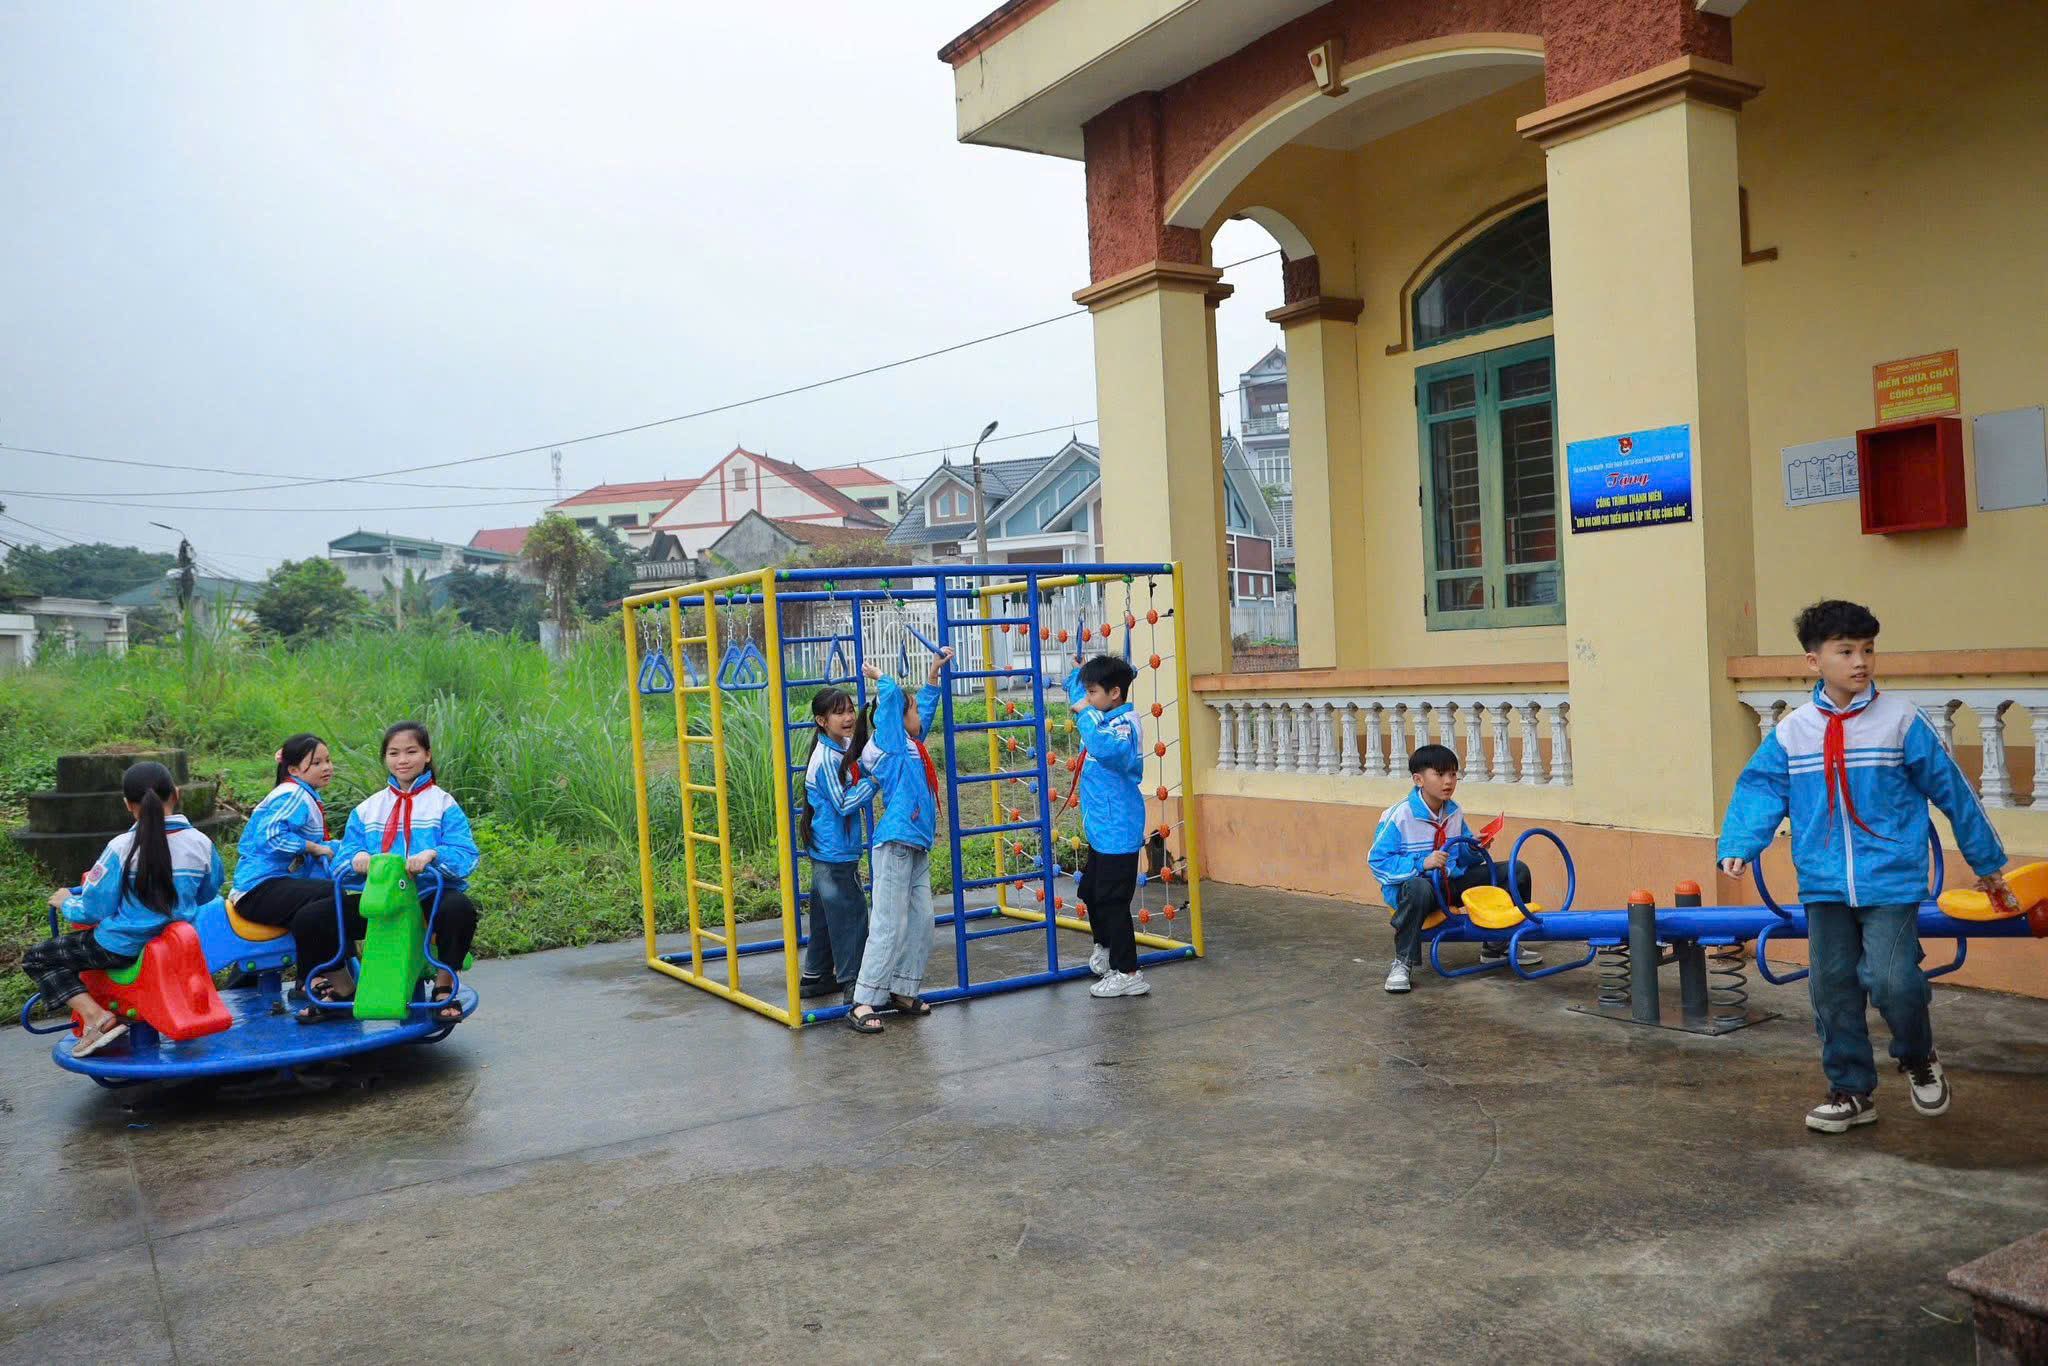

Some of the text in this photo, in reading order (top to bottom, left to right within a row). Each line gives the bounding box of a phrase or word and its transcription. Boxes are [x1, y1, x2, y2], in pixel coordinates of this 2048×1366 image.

[1596, 495, 1611, 509] CÔNG
[1629, 492, 1647, 504] THANH
[1648, 489, 1662, 502] NIÊN
